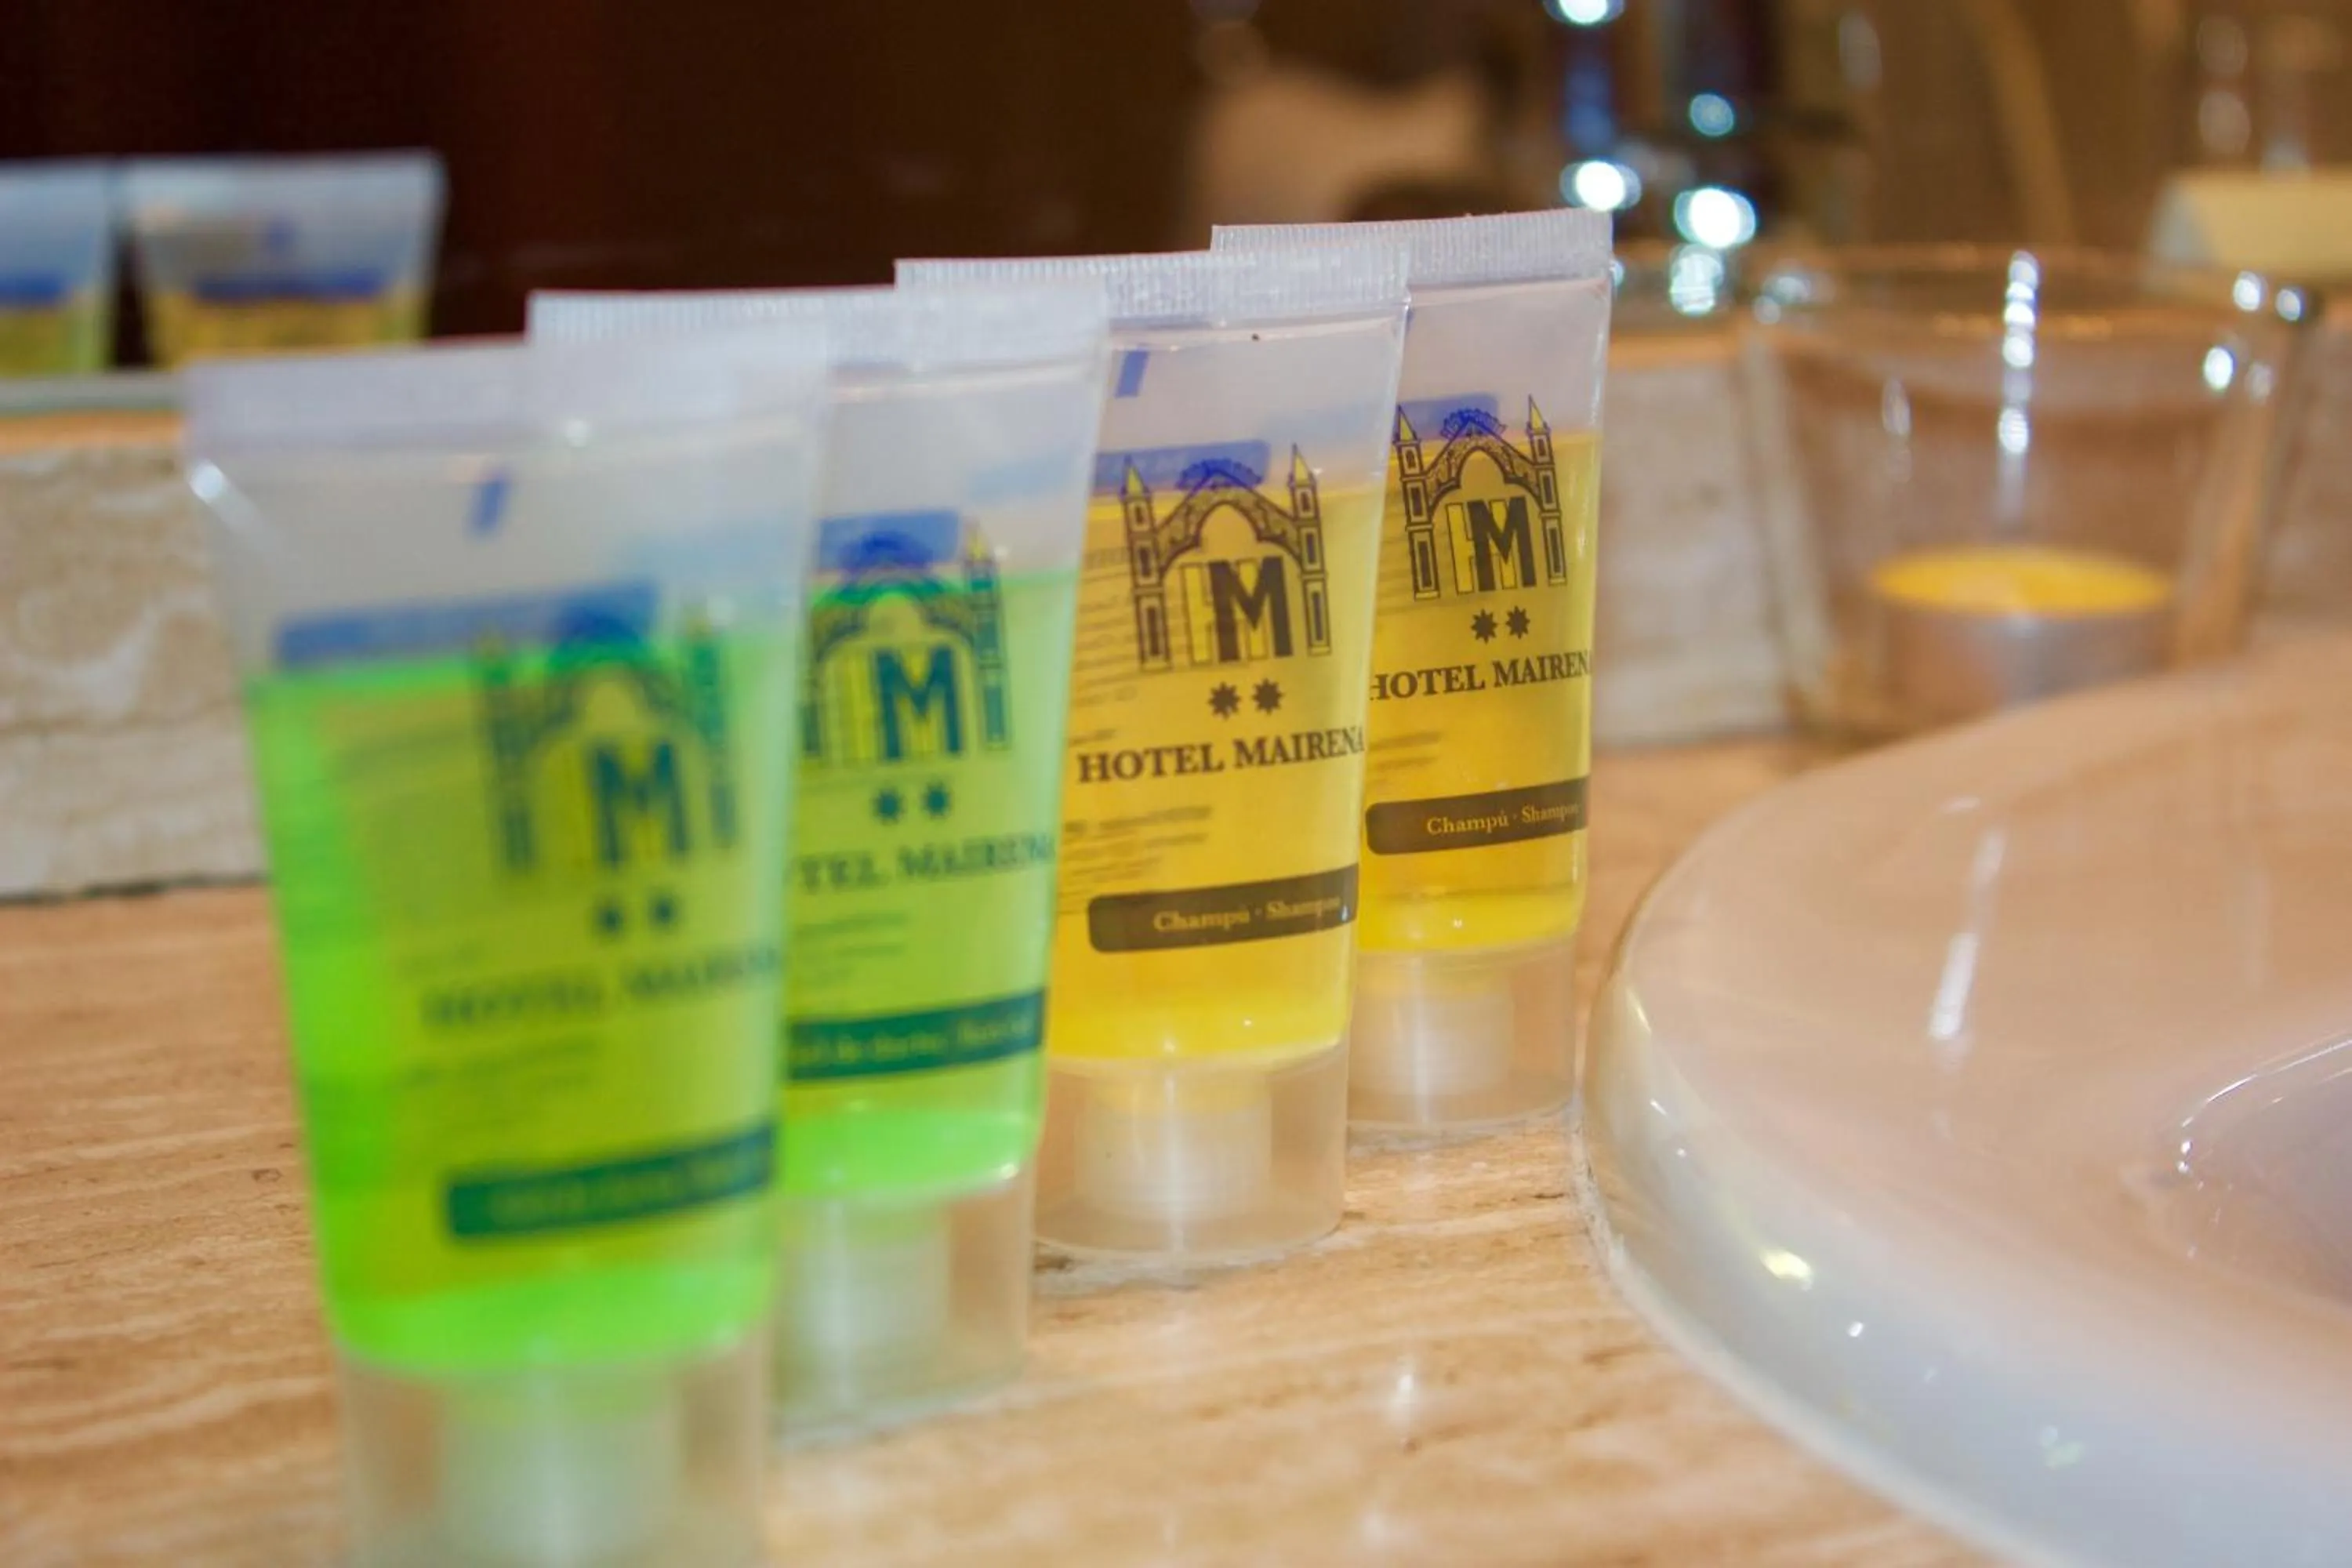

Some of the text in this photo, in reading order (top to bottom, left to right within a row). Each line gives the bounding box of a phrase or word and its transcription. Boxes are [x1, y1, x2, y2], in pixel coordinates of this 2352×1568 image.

[1493, 649, 1592, 688] MAIREN
[1078, 742, 1225, 784] HOTEL
[1427, 808, 1509, 836] Champú
